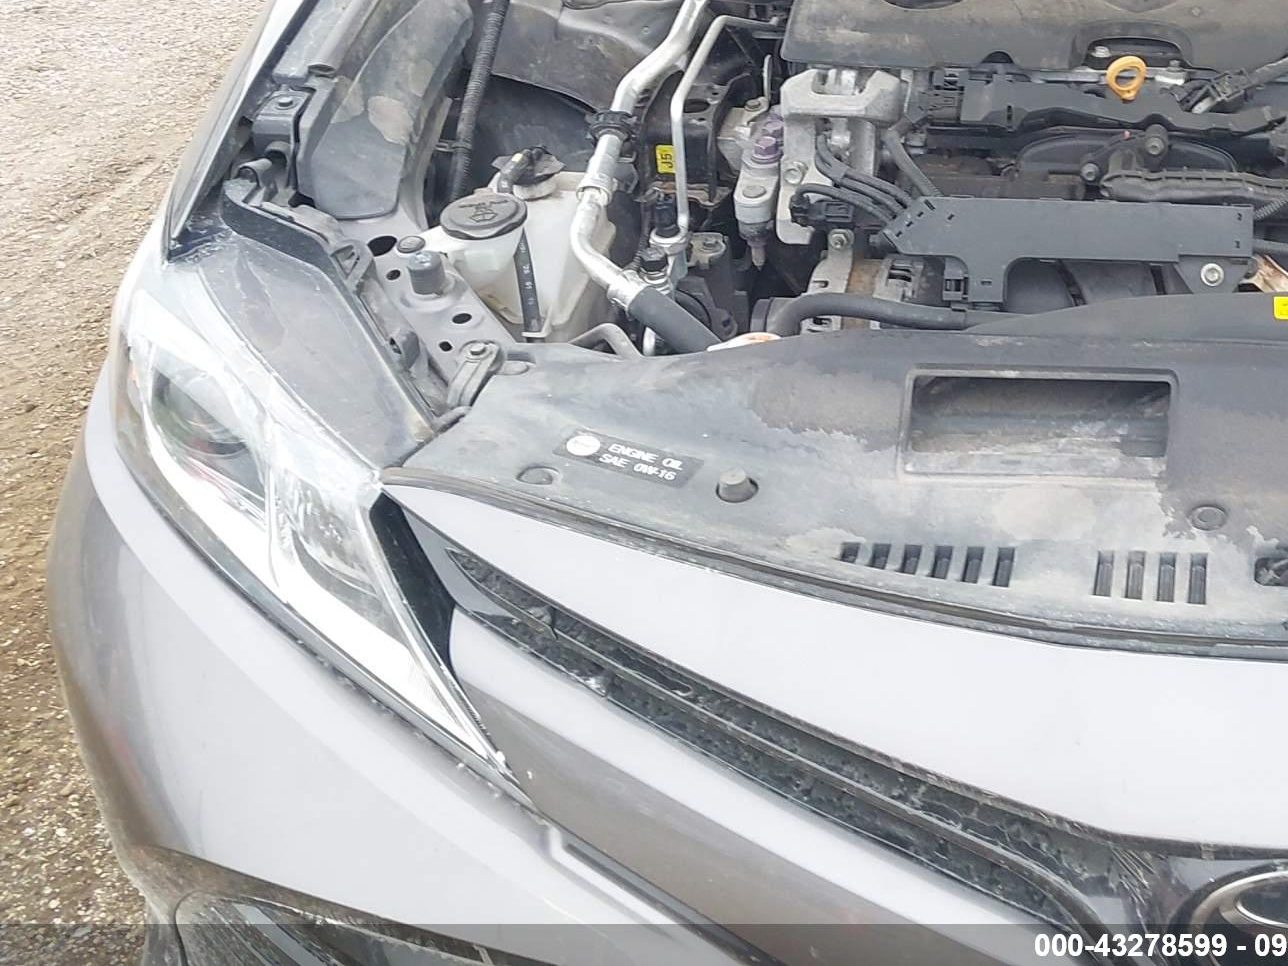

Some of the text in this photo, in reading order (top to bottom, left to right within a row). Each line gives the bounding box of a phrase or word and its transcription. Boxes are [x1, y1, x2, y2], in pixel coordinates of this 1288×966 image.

[661, 153, 673, 169] J5
[607, 443, 659, 463] ENGINE
[599, 453, 677, 480] SAE 0W-16
